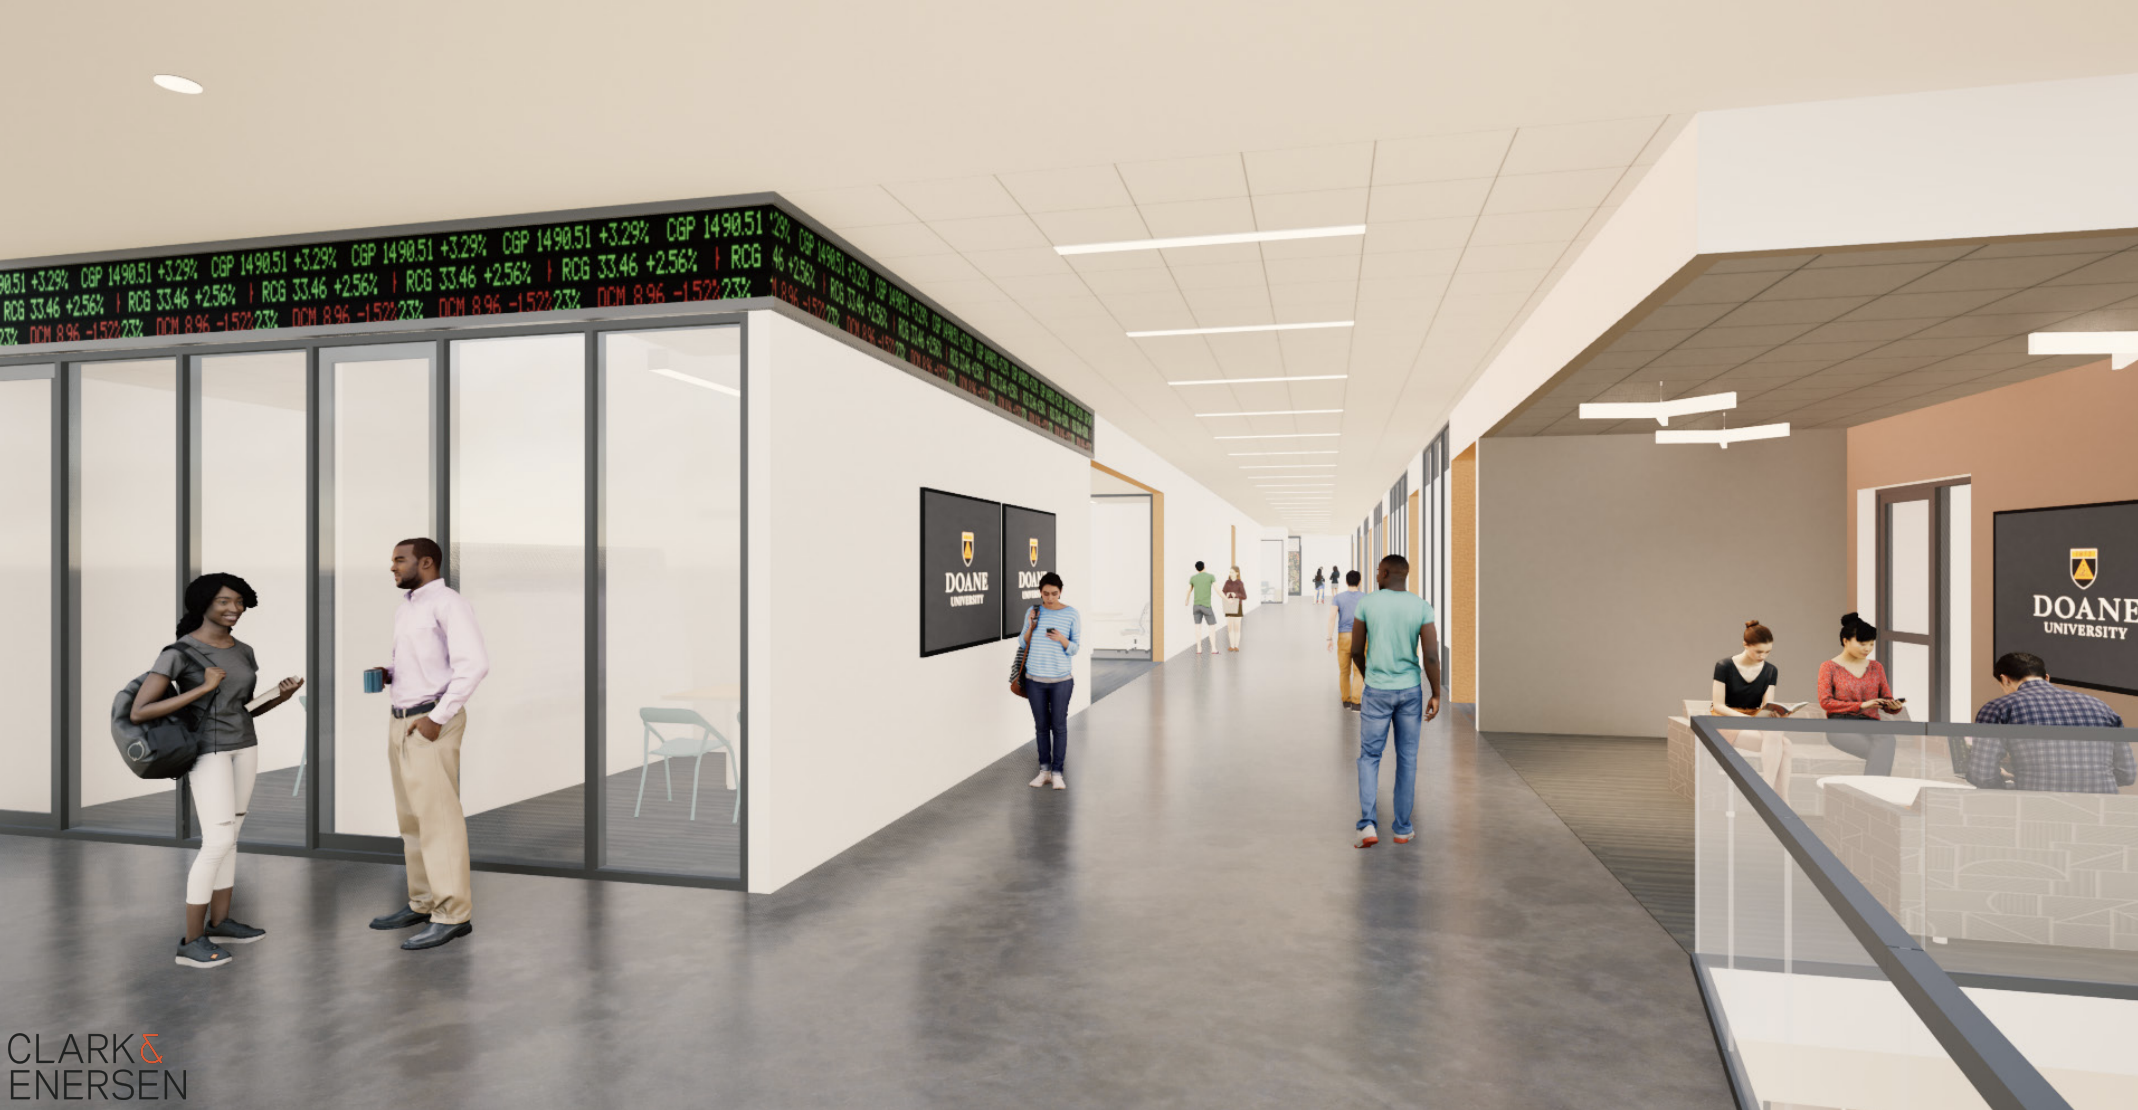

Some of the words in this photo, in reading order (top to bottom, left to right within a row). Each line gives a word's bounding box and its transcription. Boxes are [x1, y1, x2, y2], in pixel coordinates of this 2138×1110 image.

[31, 269, 69, 292] +3.29%
[80, 265, 103, 288] CGP
[108, 262, 152, 287] 1490.51
[157, 258, 198, 282] +3.29%
[211, 255, 235, 278] CGP
[240, 250, 288, 276] 1490.51
[293, 246, 337, 271] +3.29%
[351, 242, 377, 267] CGP
[383, 238, 434, 265] 1490.51
[440, 233, 487, 259] +3.29%
[502, 229, 530, 255] CGP
[537, 225, 592, 253] 1490.51
[599, 220, 650, 247] +3.29%
[666, 215, 696, 242] CGP
[704, 210, 763, 239] 1490.51
[3, 299, 25, 322] RCG
[30, 297, 61, 320] 33.46
[65, 293, 104, 317] +2.56%
[128, 289, 151, 312] RCG
[156, 286, 189, 311] 33.46
[194, 283, 236, 308] +2.56%
[261, 279, 287, 303] RCG
[292, 276, 328, 301] 33.46
[333, 272, 378, 298] +2.56%
[406, 268, 433, 293] RCG
[439, 264, 477, 291] 33.46
[483, 261, 532, 287] +2.56%
[562, 256, 590, 282] RCG
[597, 252, 639, 279] 33.46
[646, 248, 698, 275] +2.56%
[731, 242, 762, 269] RCG
[946, 573, 988, 592] DOANE
[951, 595, 983, 606] UNIVERSITY
[2033, 595, 2138, 623] DOANE
[2044, 621, 2128, 640] UNIVERSITY
